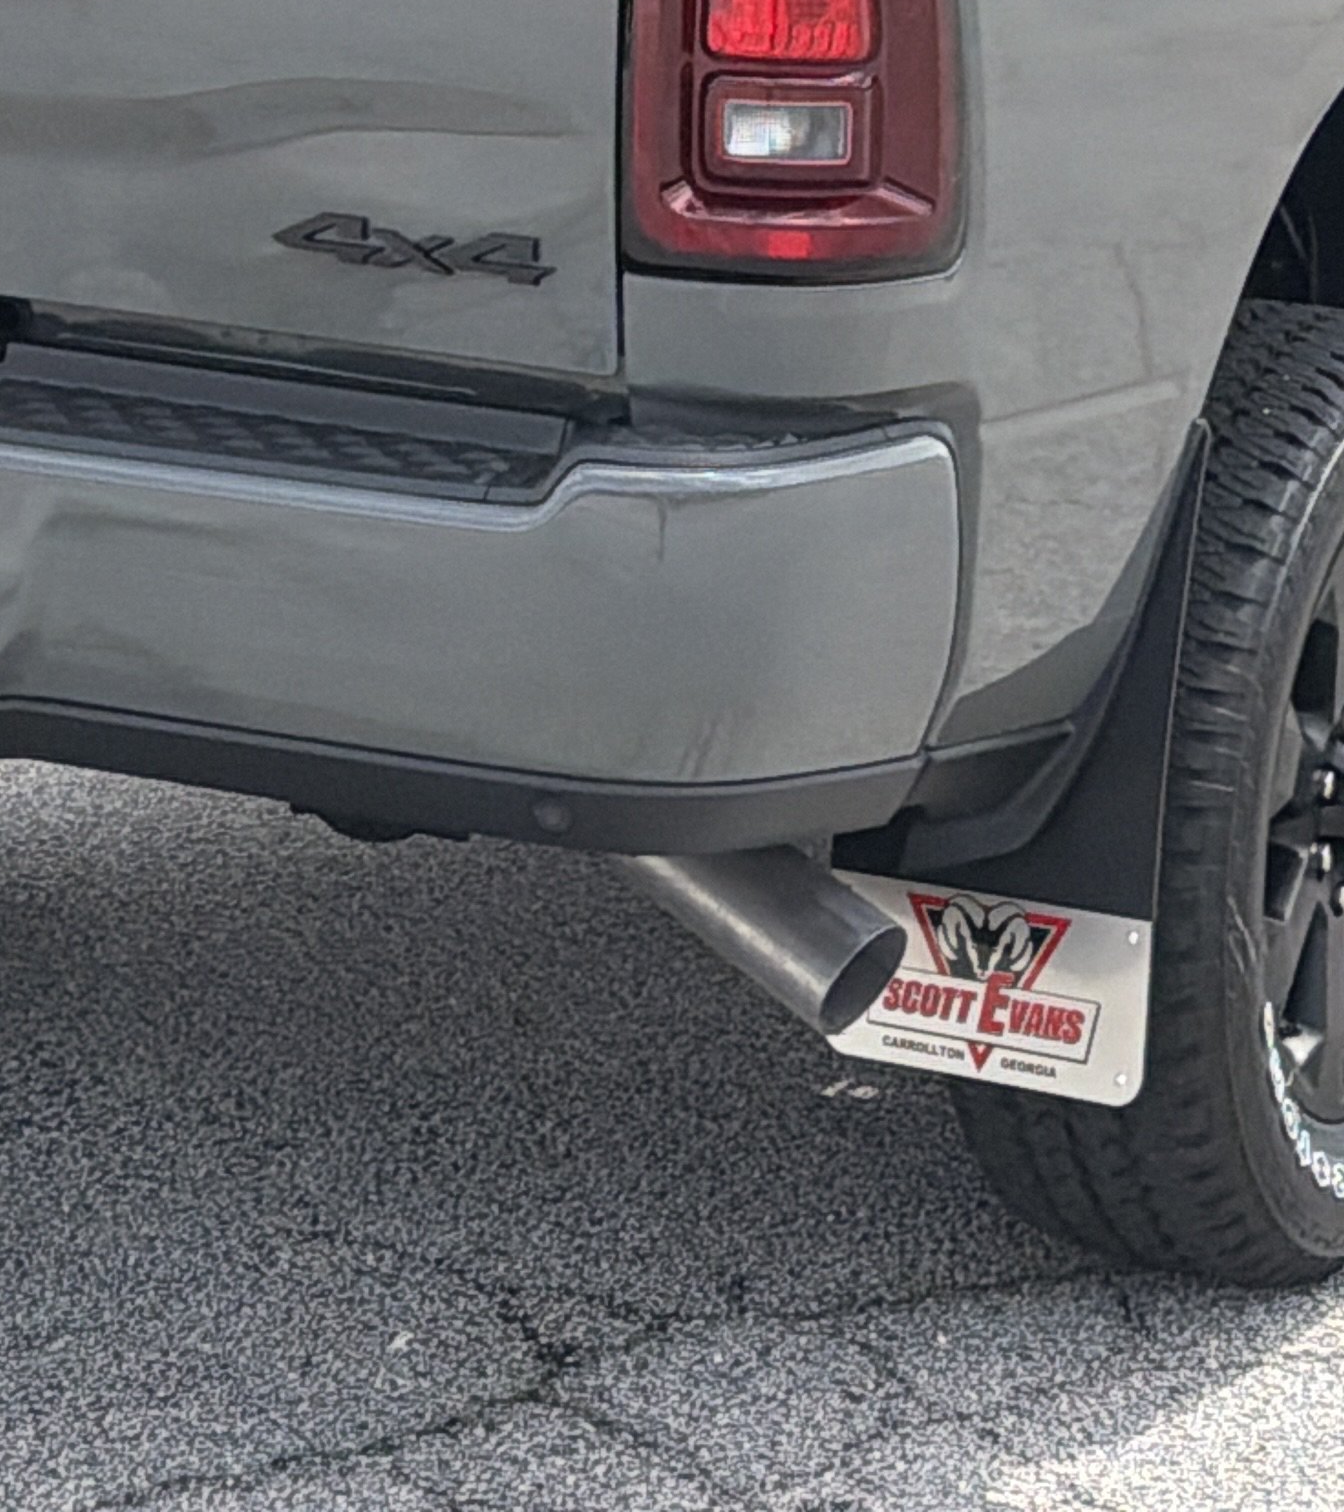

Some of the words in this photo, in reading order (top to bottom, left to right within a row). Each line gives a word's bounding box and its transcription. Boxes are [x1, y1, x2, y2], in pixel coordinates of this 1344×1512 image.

[882, 977, 978, 1024] SCOTT
[976, 971, 1085, 1045] EVANS
[882, 1034, 965, 1061] CARROLLTON
[1000, 1057, 1058, 1079] GEORGIA
